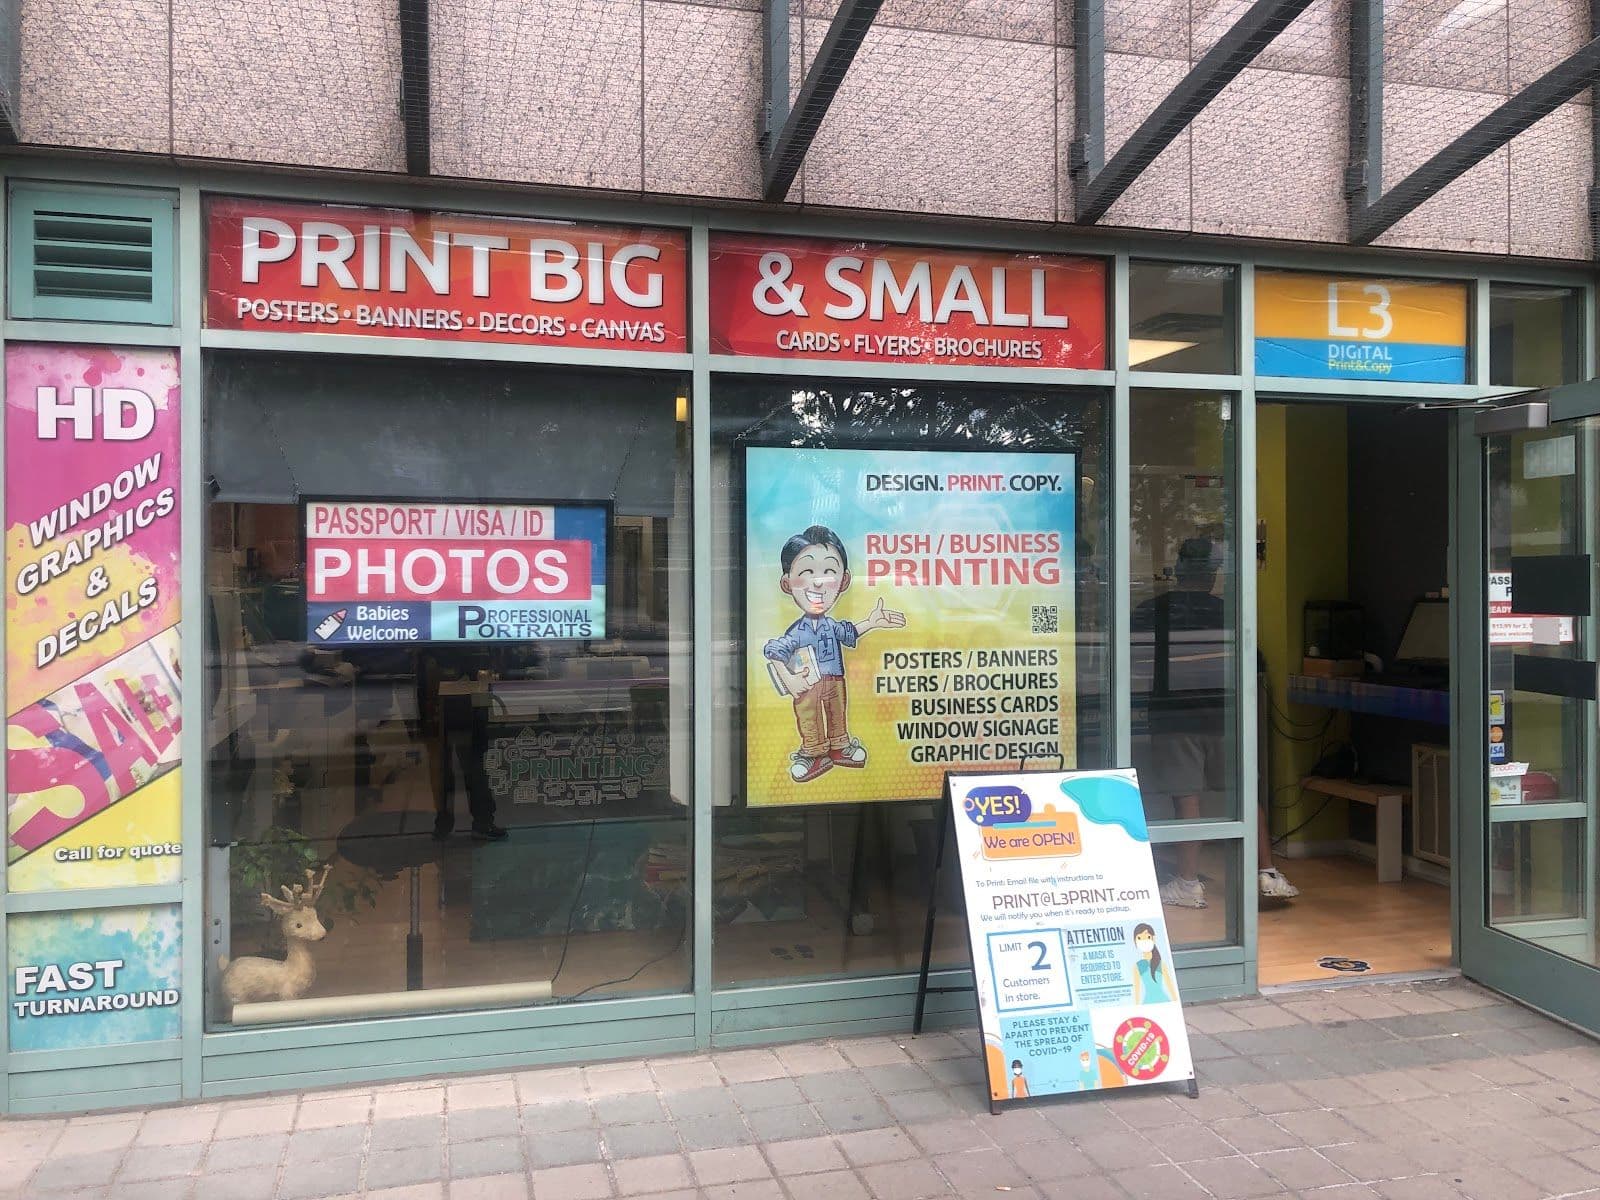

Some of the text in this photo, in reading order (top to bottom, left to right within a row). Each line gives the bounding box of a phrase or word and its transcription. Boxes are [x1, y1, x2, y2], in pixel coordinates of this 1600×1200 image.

[241, 216, 664, 308] PRINT BIG
[752, 251, 1069, 329] & SMALL
[237, 298, 665, 343] POSTERS BANNERS DECORS CANVAS
[1327, 282, 1393, 339] L3
[776, 330, 1043, 360] CARDS FLYERS BROCHURES
[37, 386, 155, 441] HD
[866, 474, 1062, 492] DESIGN. PRINT. COPY.
[29, 452, 162, 547] WINDOW
[315, 506, 436, 536] PASSPORT
[455, 508, 505, 537] VISA
[523, 509, 544, 537] ID
[17, 487, 175, 595] GRAPHICS
[866, 534, 931, 555] RUSH
[950, 533, 1060, 554] BUSINESS
[86, 566, 109, 597] &
[314, 548, 569, 596] PHOTOS
[867, 557, 1060, 587] PRINTING
[37, 577, 158, 669] DECALS
[356, 605, 409, 622] Babies
[458, 605, 593, 624] PROFESSIONAL
[347, 625, 419, 641] Welcome
[884, 651, 962, 670] POSTERS
[977, 649, 1058, 669] BANNERS
[876, 675, 938, 694] FLYERS
[953, 672, 1058, 692] BROCHURES
[911, 695, 1059, 716] BUSINESS CARDS
[897, 718, 1059, 740] WINDOW SIGNAGE
[911, 741, 1059, 763] GRAPHIC DESIGN
[510, 754, 654, 782] PRINTING
[975, 795, 1021, 816] YES!
[984, 832, 1075, 849] We are OPEN!
[55, 842, 181, 862] Call for quote
[1007, 877, 1027, 887] Email
[992, 888, 1151, 910] PRINT@L3PRINT.com
[980, 914, 993, 922] We
[1068, 926, 1125, 945] ATTENTION
[999, 942, 1022, 952] LIMIT
[1027, 941, 1051, 970] 2
[15, 959, 123, 995] FAST
[1003, 977, 1050, 988] Customers
[14, 989, 179, 1017] TURNAROUND
[1005, 1024, 1089, 1039] APART TO PREVENT
[1013, 1018, 1045, 1029] PLEASE
[1048, 1016, 1070, 1026] STAY
[1015, 1034, 1083, 1049] THE SPREAD OF
